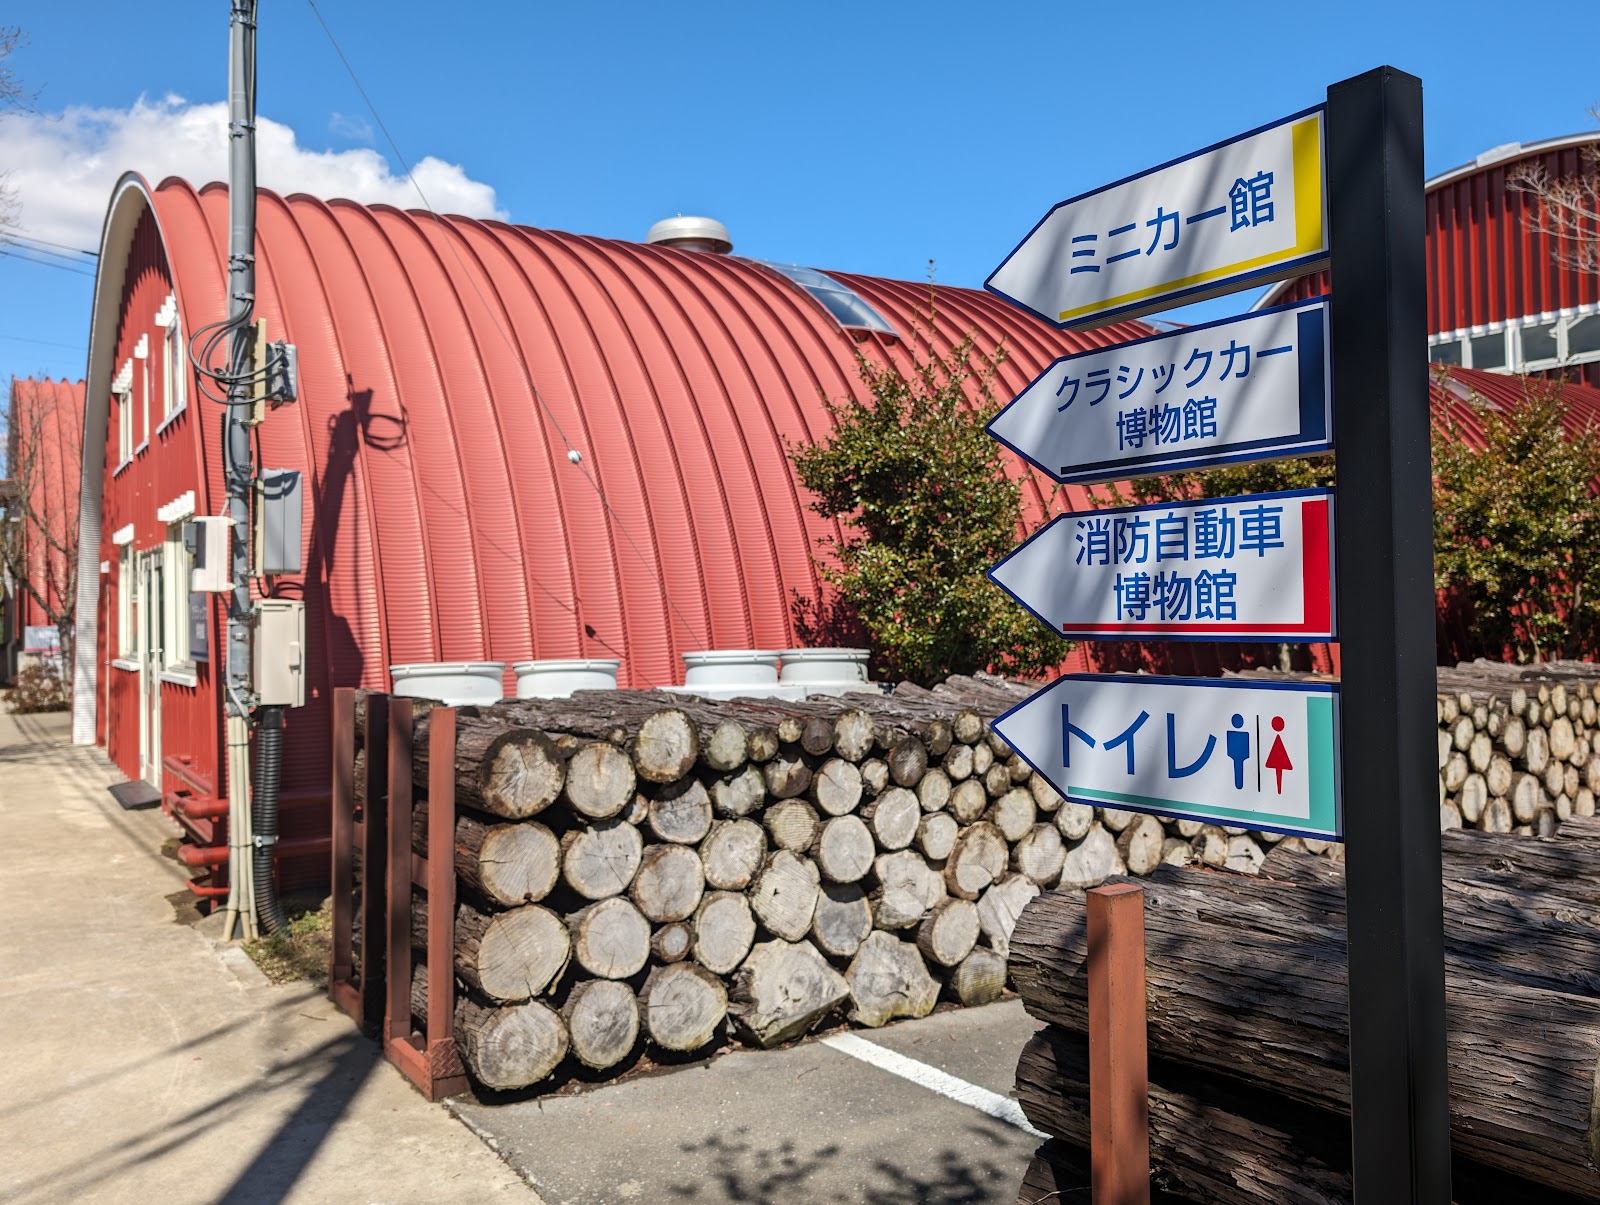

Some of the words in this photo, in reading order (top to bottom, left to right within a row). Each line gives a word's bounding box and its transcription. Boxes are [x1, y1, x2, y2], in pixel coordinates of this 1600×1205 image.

[1070, 171, 1274, 274] ミニカー館
[1055, 340, 1293, 412] クラシックカー
[1116, 396, 1217, 451] 博物館
[1075, 504, 1285, 566] 消防自動車
[1114, 569, 1237, 621] 博物館
[1062, 704, 1217, 778] トイレ
